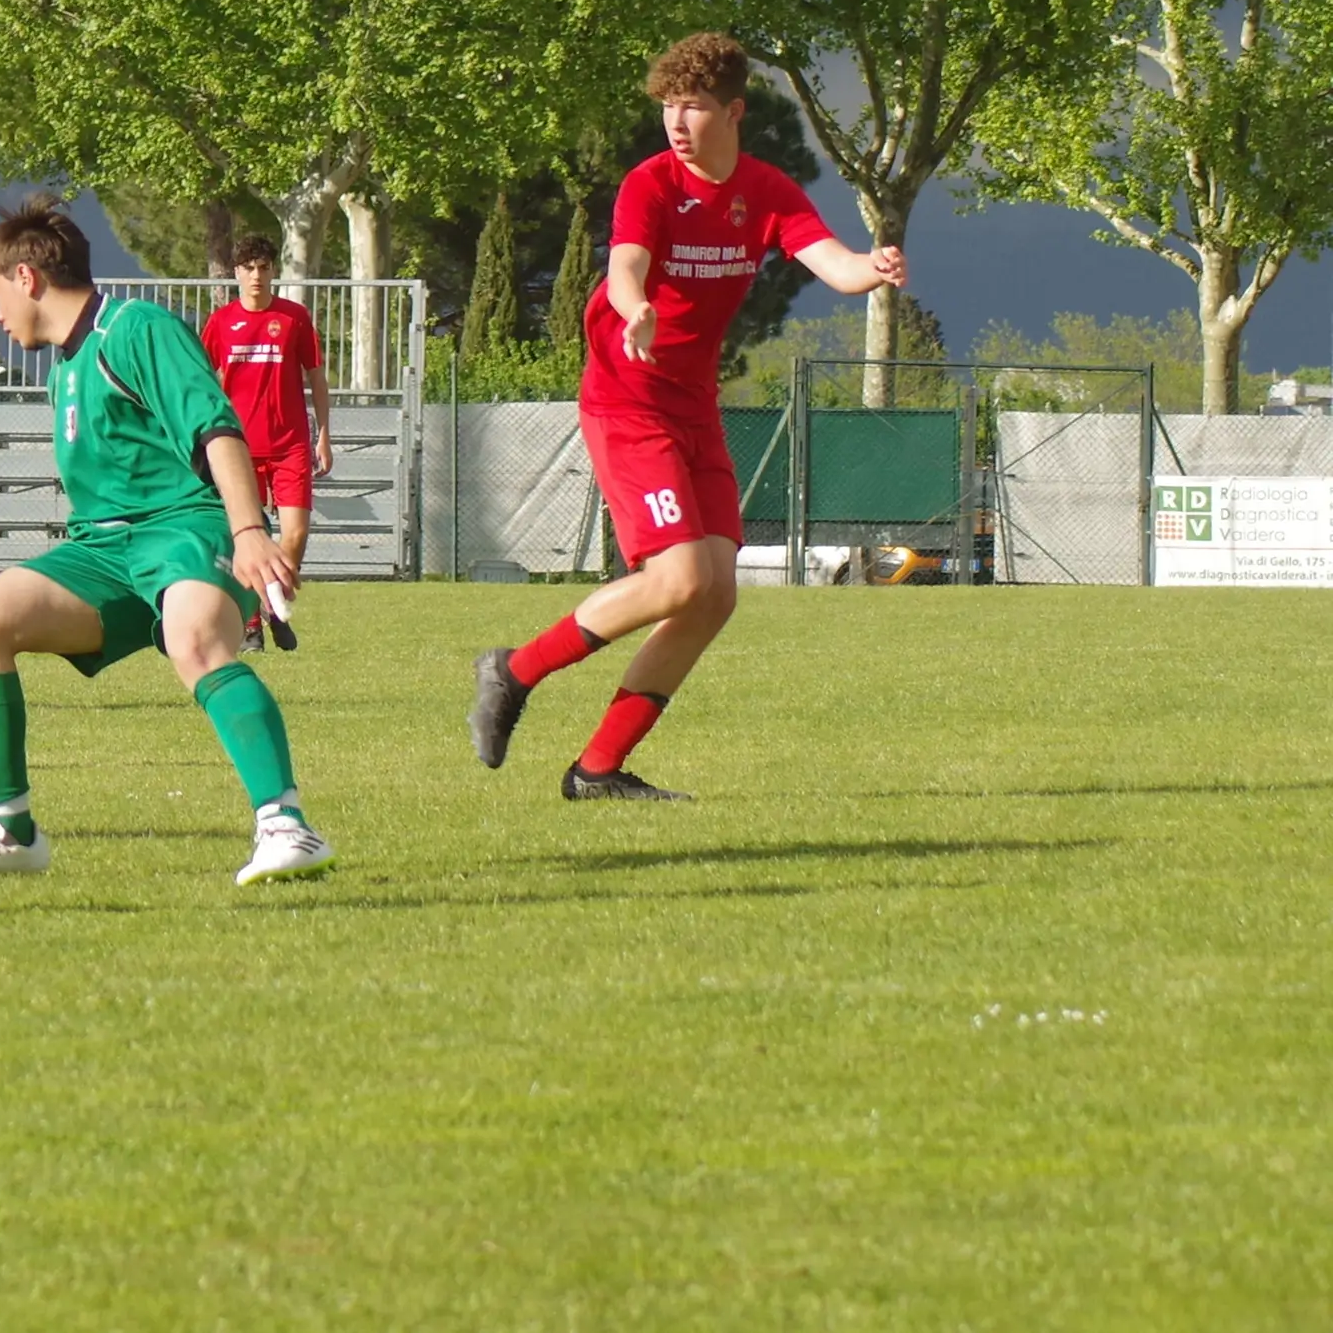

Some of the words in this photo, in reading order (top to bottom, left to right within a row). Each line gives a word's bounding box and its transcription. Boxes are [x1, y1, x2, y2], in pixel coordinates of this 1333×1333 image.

[1220, 487, 1308, 504] Radiologia
[644, 488, 682, 527] 18
[1220, 507, 1319, 524] Diagnostica
[1219, 527, 1286, 542] Valdera
[1236, 556, 1254, 566] Via
[1256, 556, 1267, 566] di
[1270, 556, 1302, 568] Gello,
[1306, 557, 1325, 566] 175
[1168, 569, 1317, 582] www.diagnosticavaldera.it
